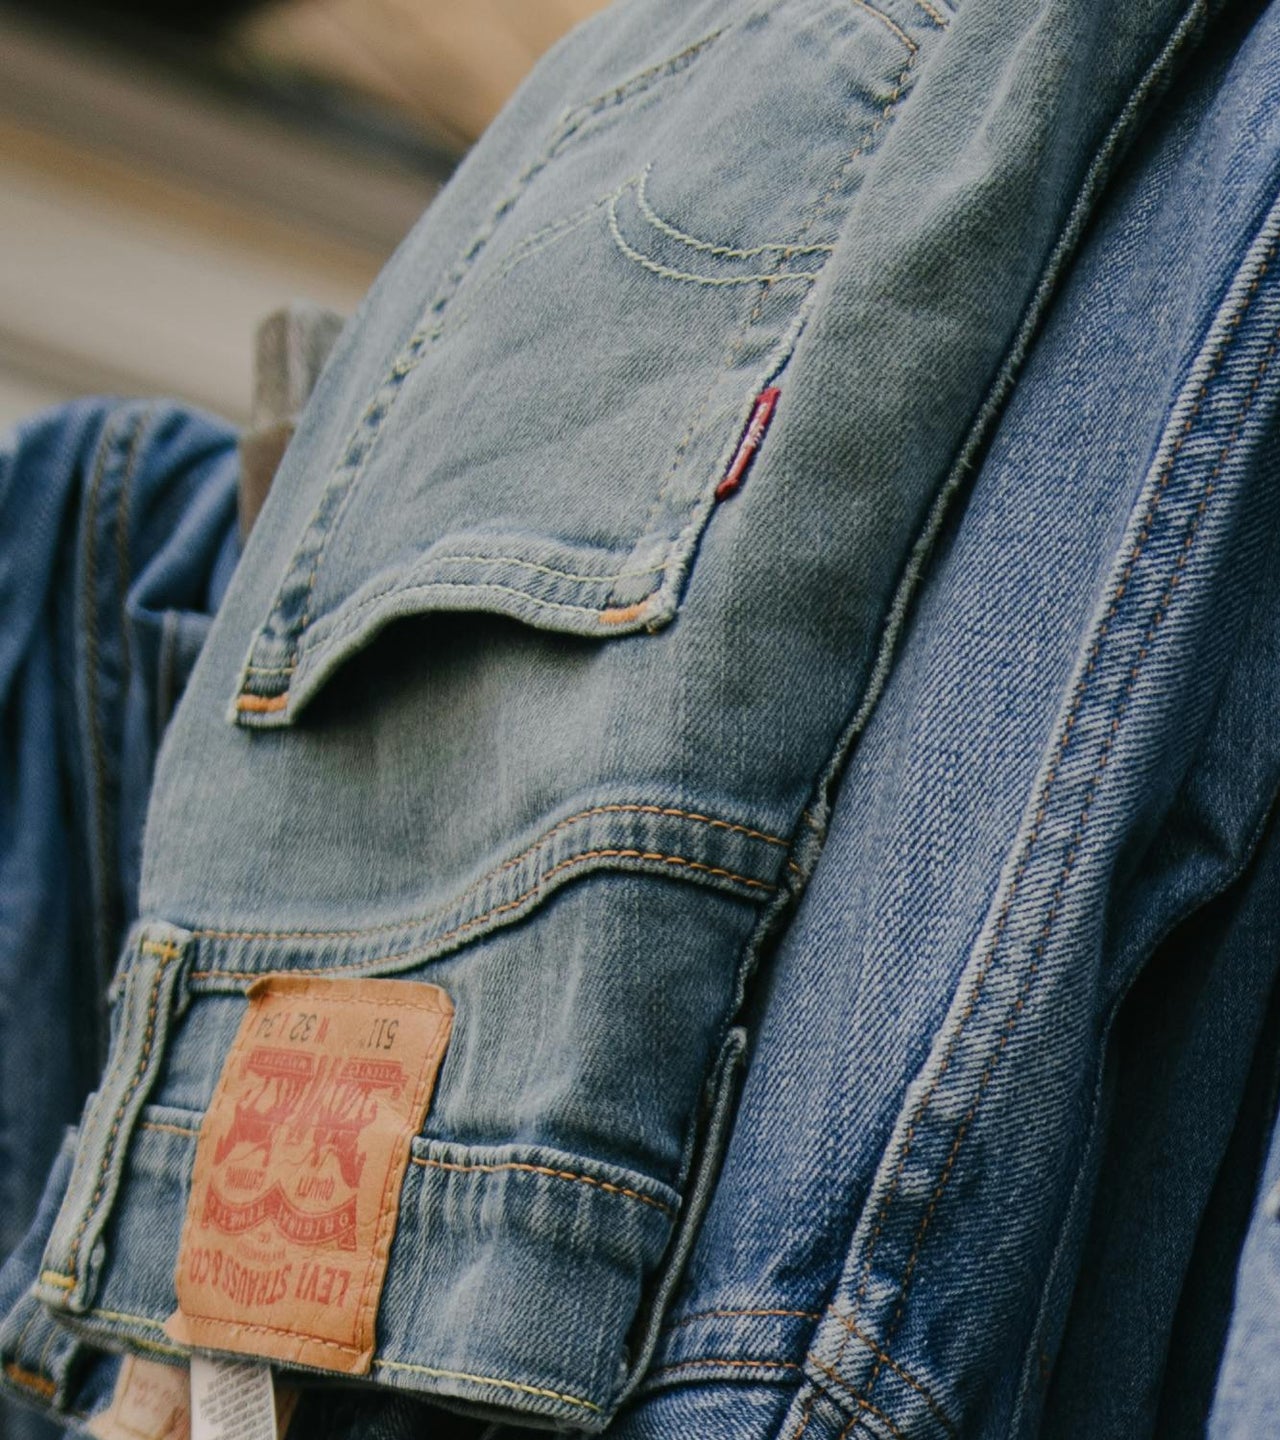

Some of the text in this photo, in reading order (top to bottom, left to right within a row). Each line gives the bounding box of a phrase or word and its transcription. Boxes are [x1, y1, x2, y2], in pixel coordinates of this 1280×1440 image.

[289, 1013, 317, 1041] 32
[210, 1255, 221, 1285] &
[221, 1256, 291, 1307] STRAUSS
[295, 1262, 352, 1307] LEVI
